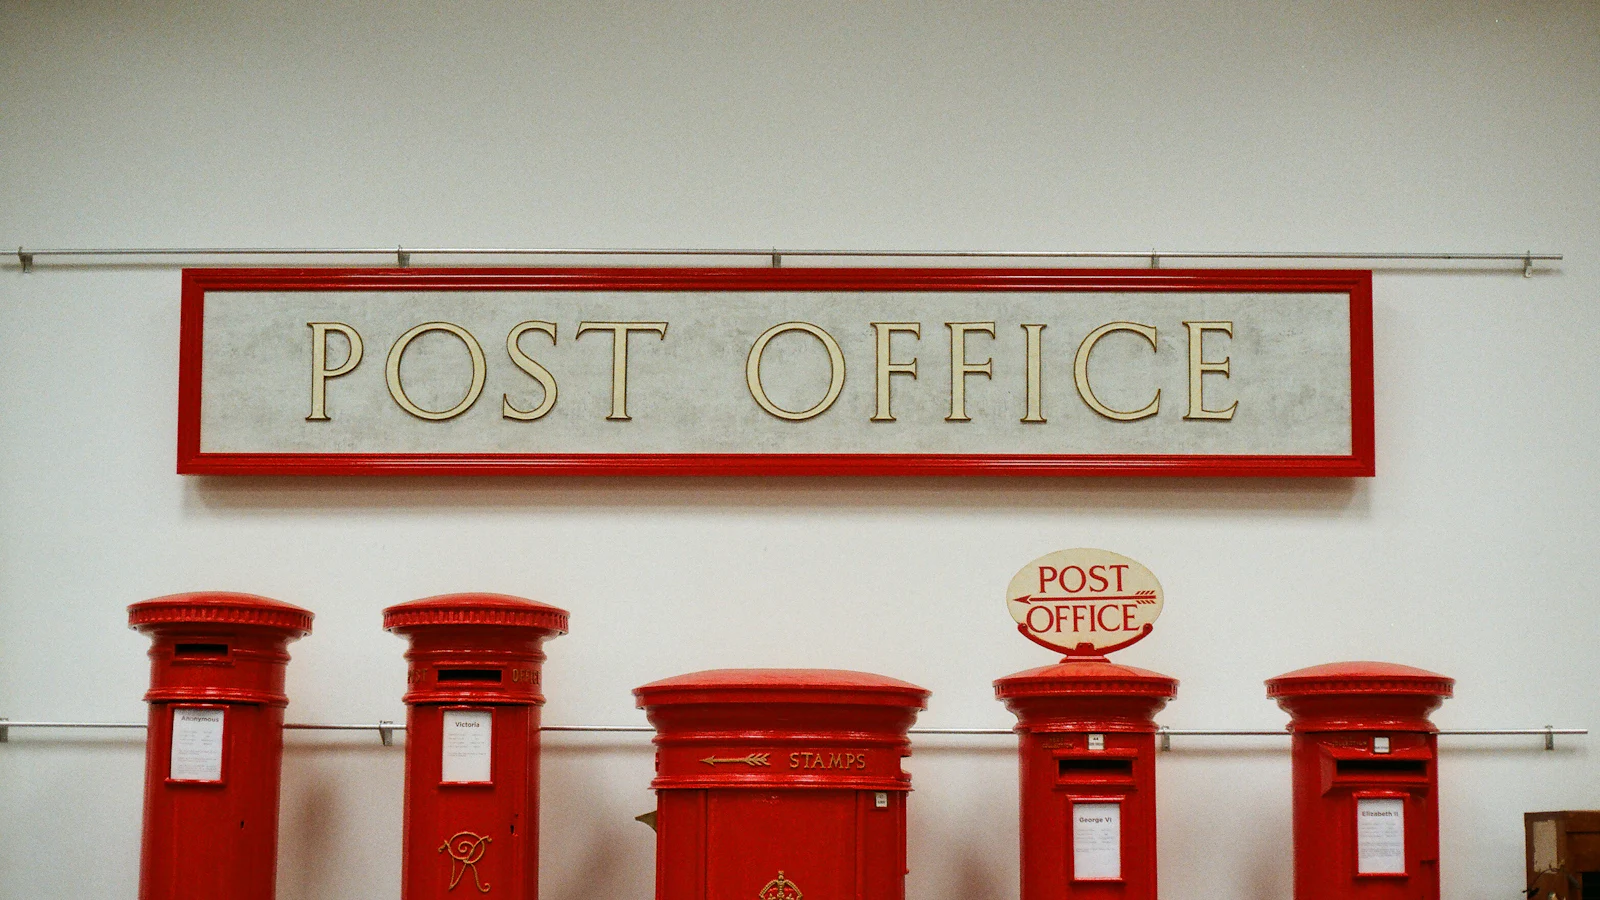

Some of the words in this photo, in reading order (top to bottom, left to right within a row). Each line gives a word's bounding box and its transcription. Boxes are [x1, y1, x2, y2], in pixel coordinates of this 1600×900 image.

[305, 320, 668, 422] POST
[745, 320, 1239, 423] OFFICE
[1038, 564, 1129, 593] POST
[1026, 603, 1140, 633] OFFICE
[789, 752, 866, 769] STAMPS
